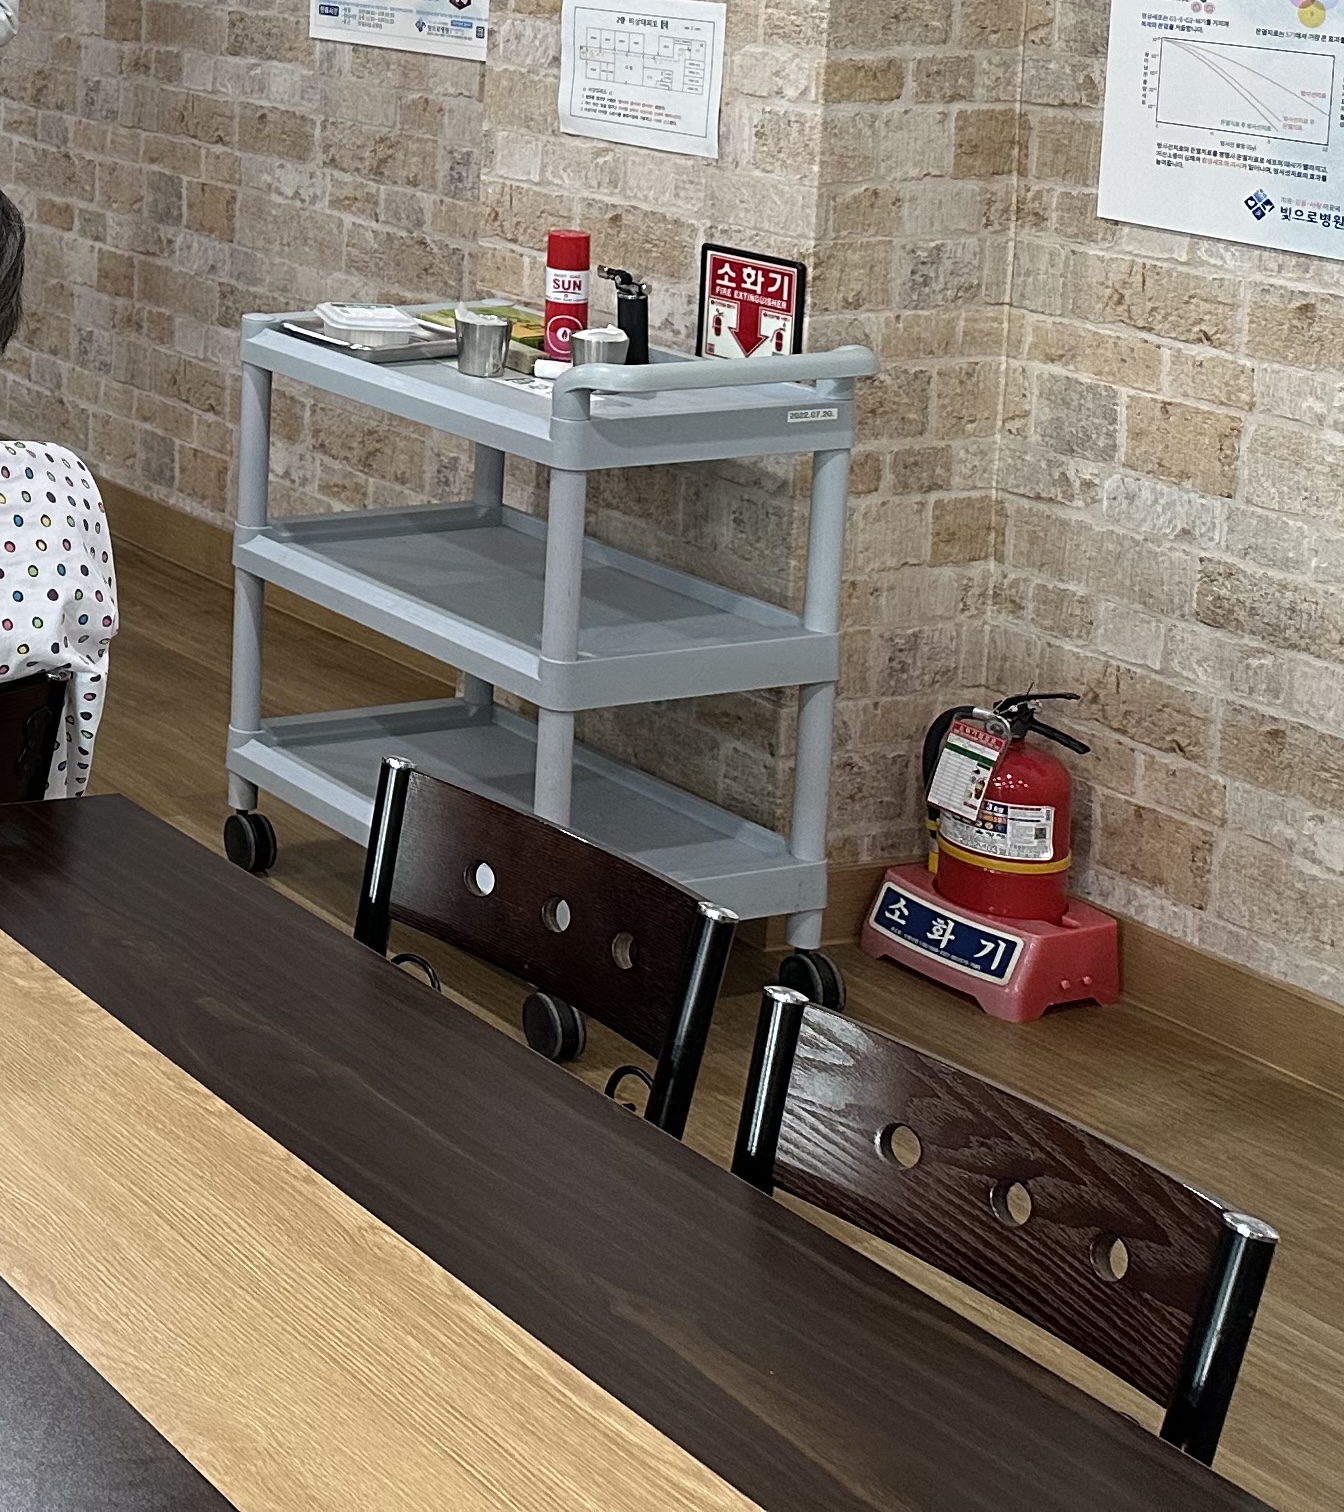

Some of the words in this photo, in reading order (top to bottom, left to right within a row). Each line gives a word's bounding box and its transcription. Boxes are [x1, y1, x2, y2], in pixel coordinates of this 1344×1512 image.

[1280, 206, 1344, 229] 빛으로병원
[552, 278, 582, 292] SUN
[716, 263, 788, 300] 소화기
[716, 286, 732, 296] FIRE
[734, 290, 787, 309] EXTINGUISHER
[789, 410, 835, 420] 2022.07.20.
